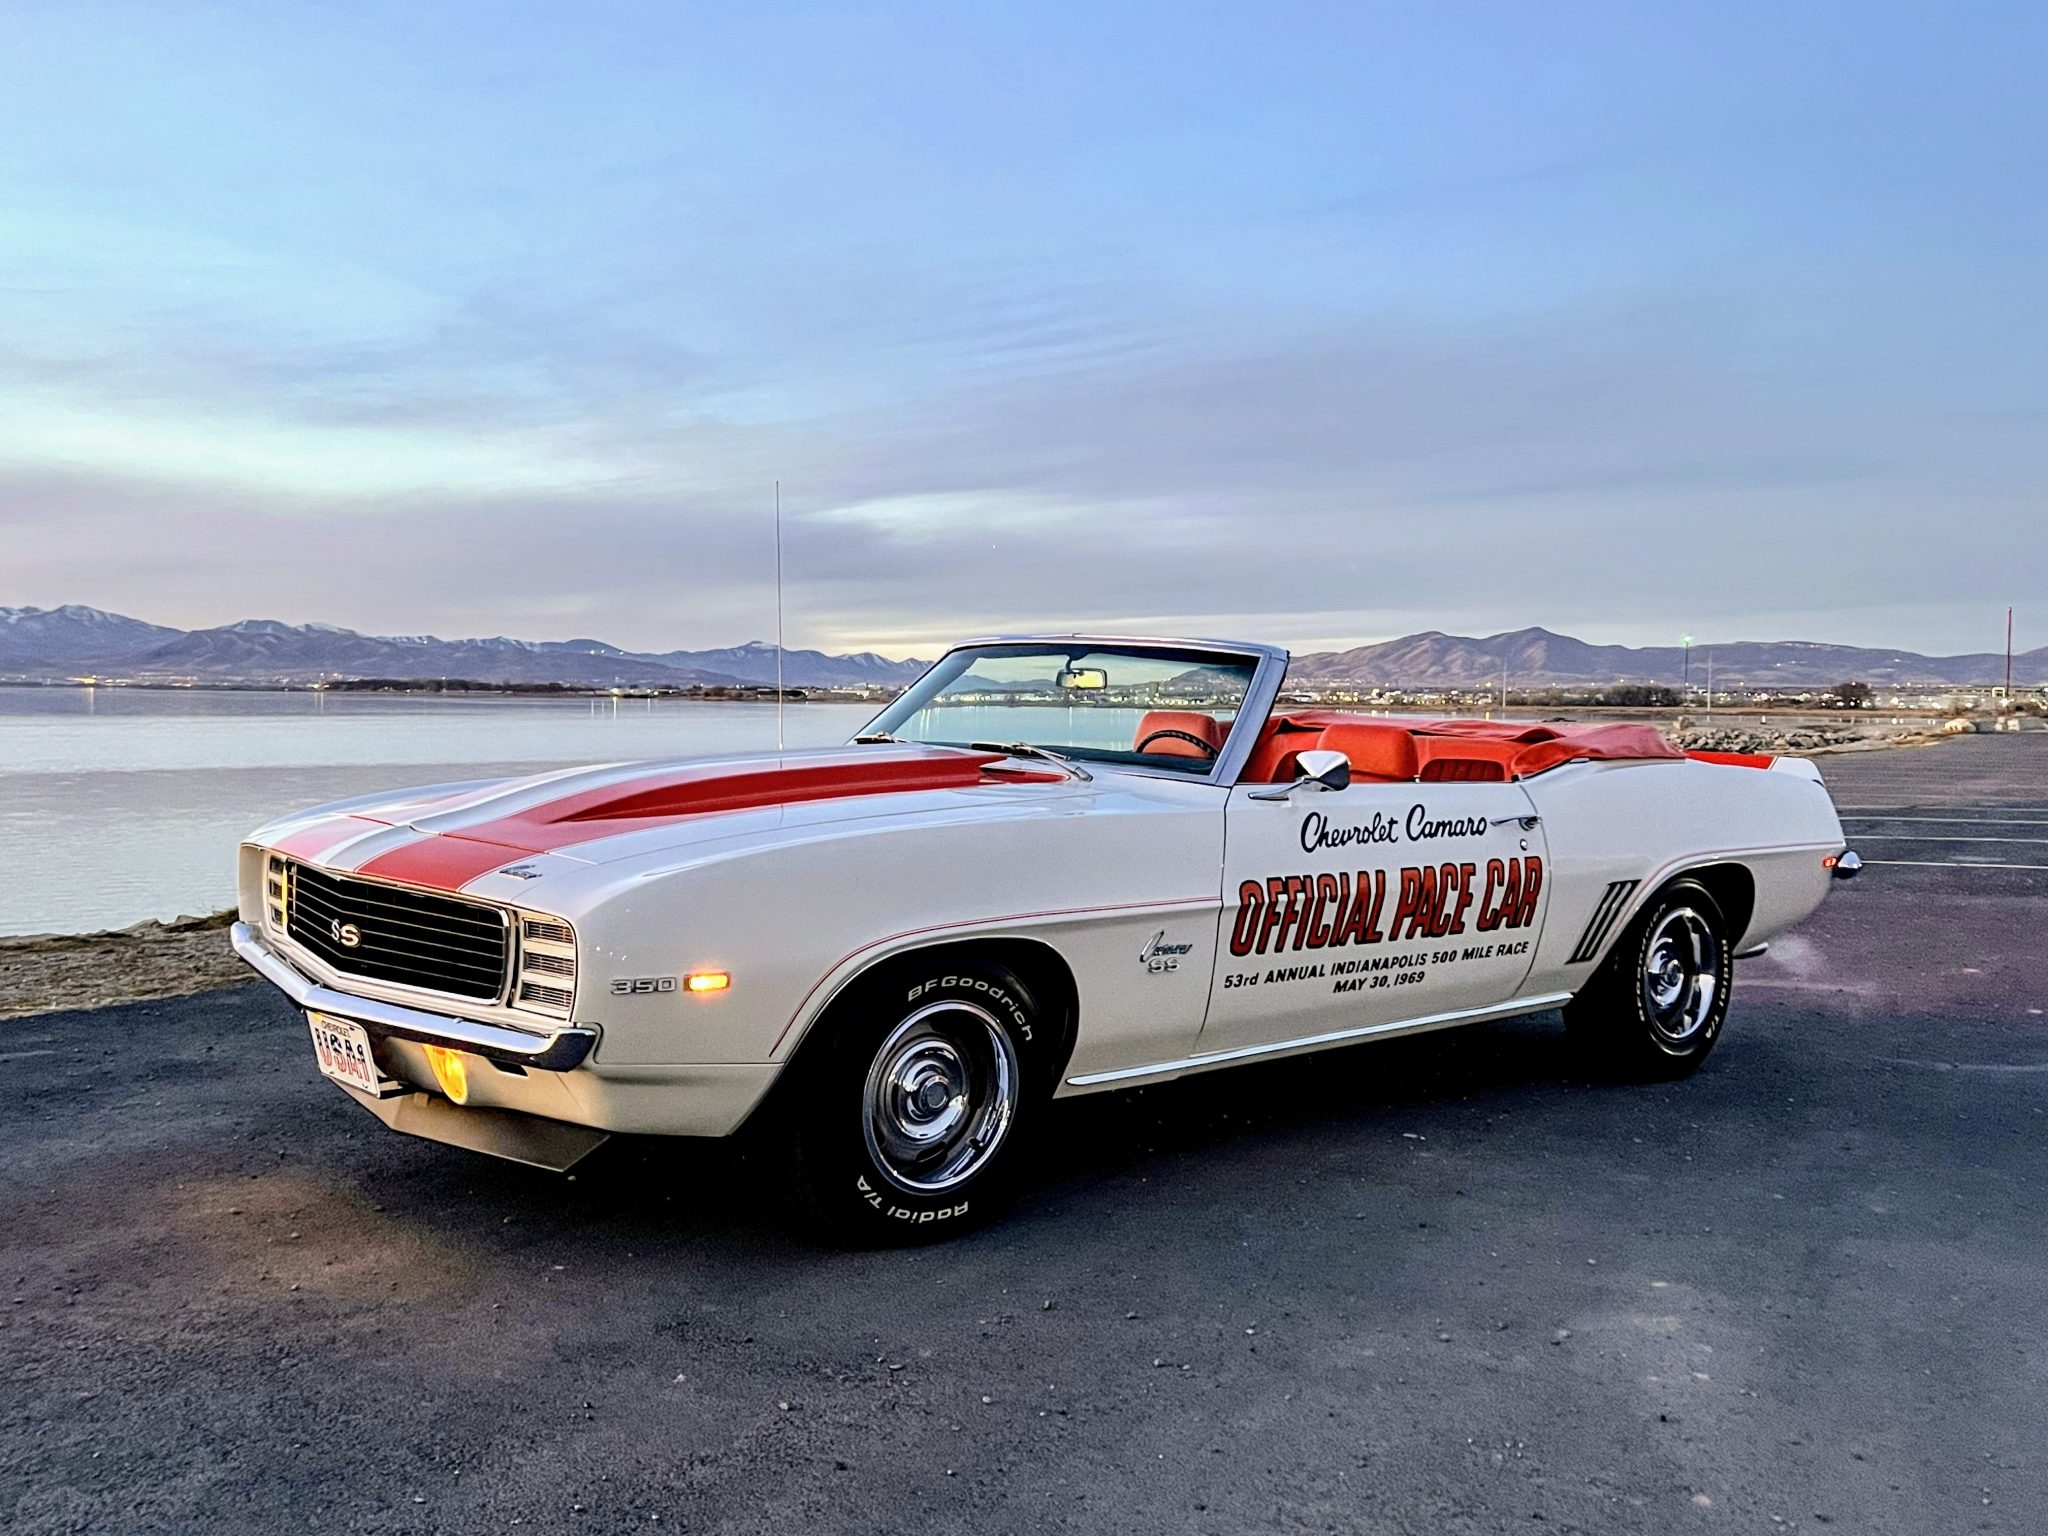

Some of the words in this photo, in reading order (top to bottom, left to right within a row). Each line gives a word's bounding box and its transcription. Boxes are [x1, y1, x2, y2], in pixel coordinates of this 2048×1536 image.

[1301, 811, 1398, 853] Chevrolet
[1405, 803, 1487, 842] Camaro
[1229, 869, 1386, 957] OFFICIAL
[1389, 862, 1476, 942] PACE
[1476, 855, 1543, 931] CAR
[331, 919, 361, 948] SS
[1147, 956, 1181, 974] SS
[1224, 972, 1260, 989] 53rd
[1264, 964, 1326, 984] ANNUAL
[1330, 953, 1428, 976] INDIANAPOLIS
[1431, 950, 1458, 964] 500
[1461, 945, 1494, 961] MILE
[1496, 941, 1530, 957] RACE
[611, 976, 677, 995] 350
[1333, 977, 1368, 993] MAY
[1369, 975, 1391, 989] 30,
[1394, 971, 1425, 987] 1969
[907, 975, 1033, 1042] BFGoodrich
[856, 1174, 883, 1209] T/A
[886, 1200, 969, 1224] Radial
